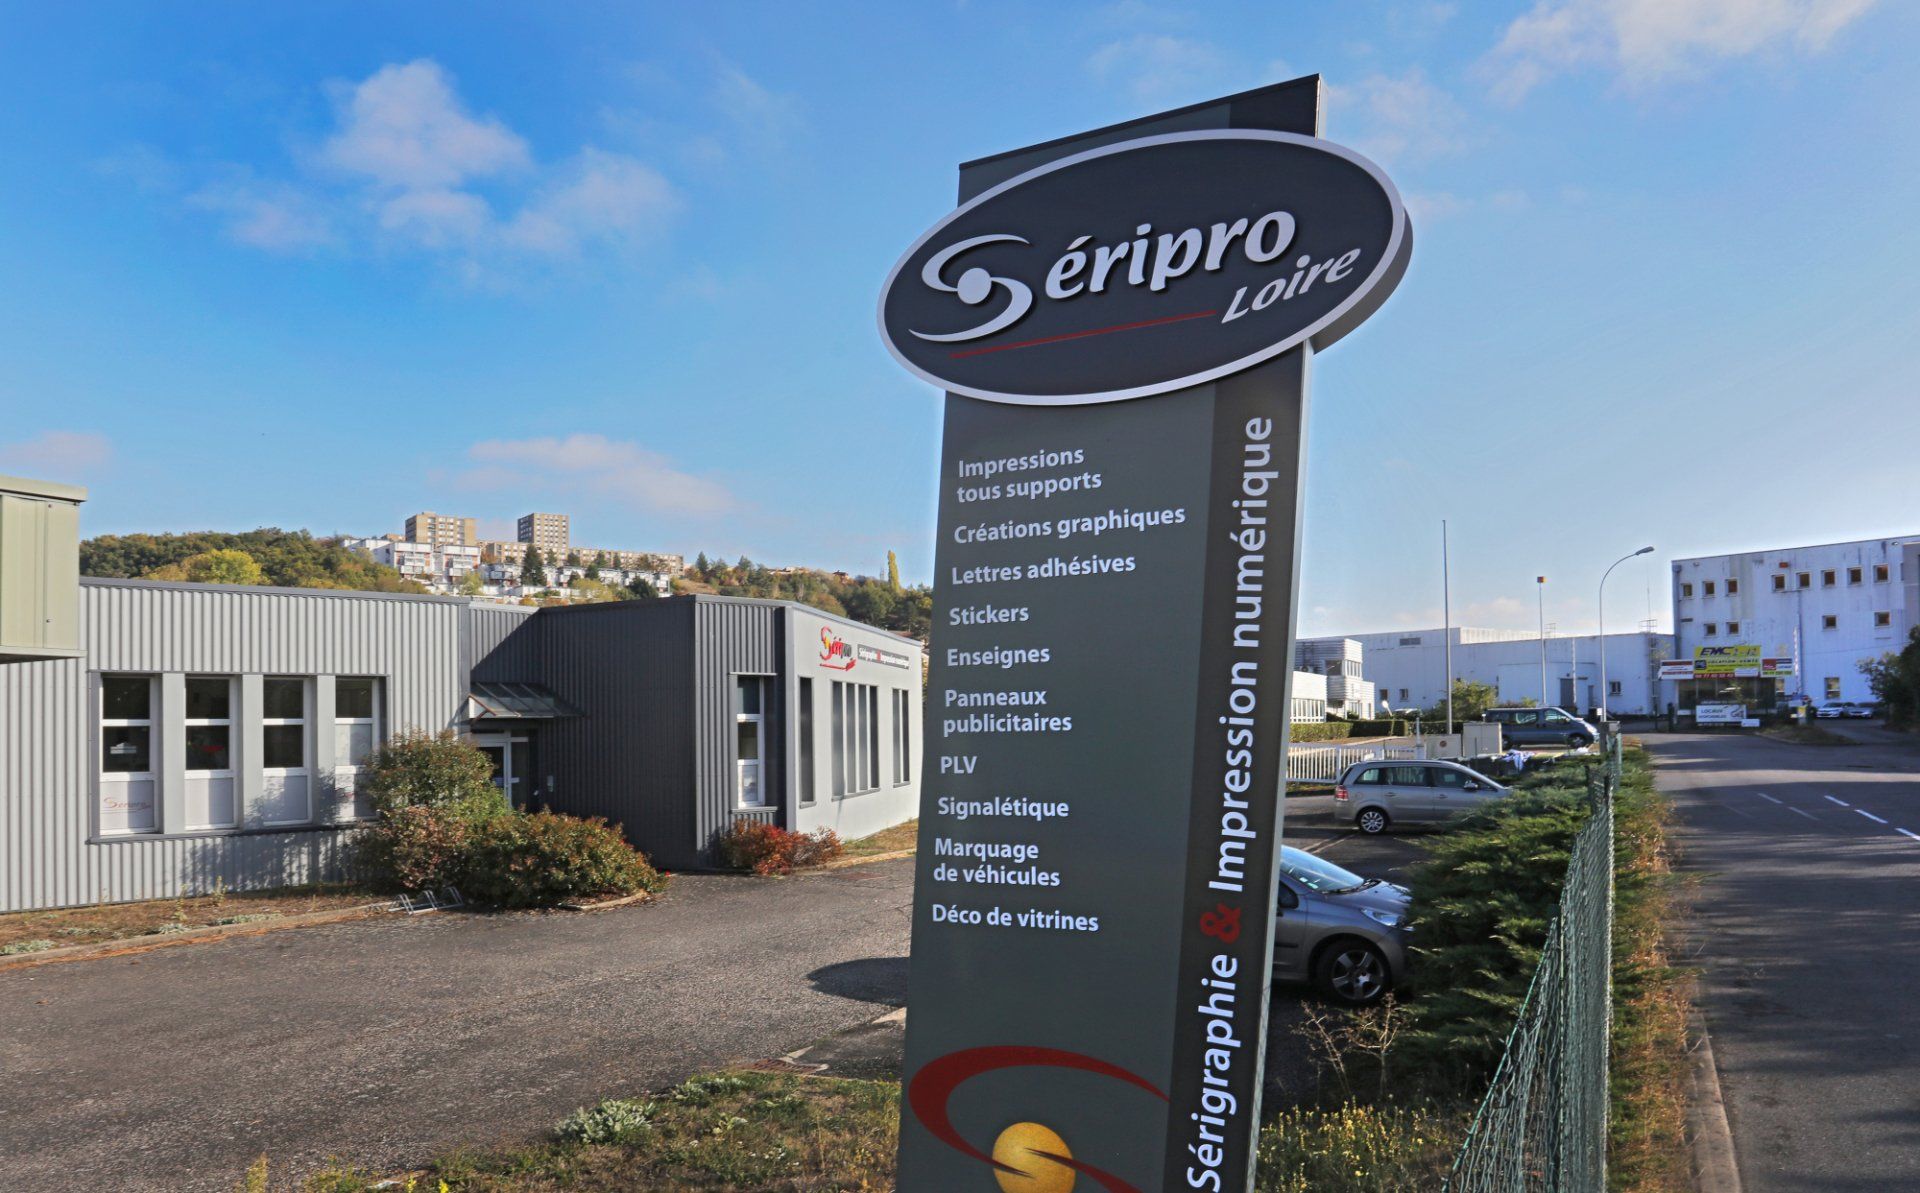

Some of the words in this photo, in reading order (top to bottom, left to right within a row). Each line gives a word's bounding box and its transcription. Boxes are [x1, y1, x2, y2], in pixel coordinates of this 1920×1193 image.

[1221, 248, 1361, 324] Loire
[958, 449, 1085, 480] Impressions
[957, 484, 1001, 503] tous
[1006, 471, 1102, 500] supports
[954, 519, 1051, 544] Créations
[1056, 507, 1186, 539] graphiques
[1229, 416, 1279, 648] numérique
[952, 565, 1022, 585] Lettres
[1027, 554, 1136, 579] adhésives
[949, 604, 1029, 626] Stickers
[947, 645, 1050, 669] Enseignes
[944, 689, 1047, 707] Panneaux
[943, 712, 1072, 738] publicitaires
[940, 755, 978, 774] PLV
[1208, 661, 1258, 892] Impression
[937, 796, 1070, 822] Signalétique
[934, 837, 1039, 863] Marquage
[933, 862, 958, 882] de
[962, 864, 1060, 887] véhicules
[932, 903, 981, 925] Déco
[986, 906, 1012, 926] de
[1017, 908, 1099, 932] vitrines
[1199, 903, 1241, 943] &
[1187, 954, 1240, 1193] Sérigraphie
